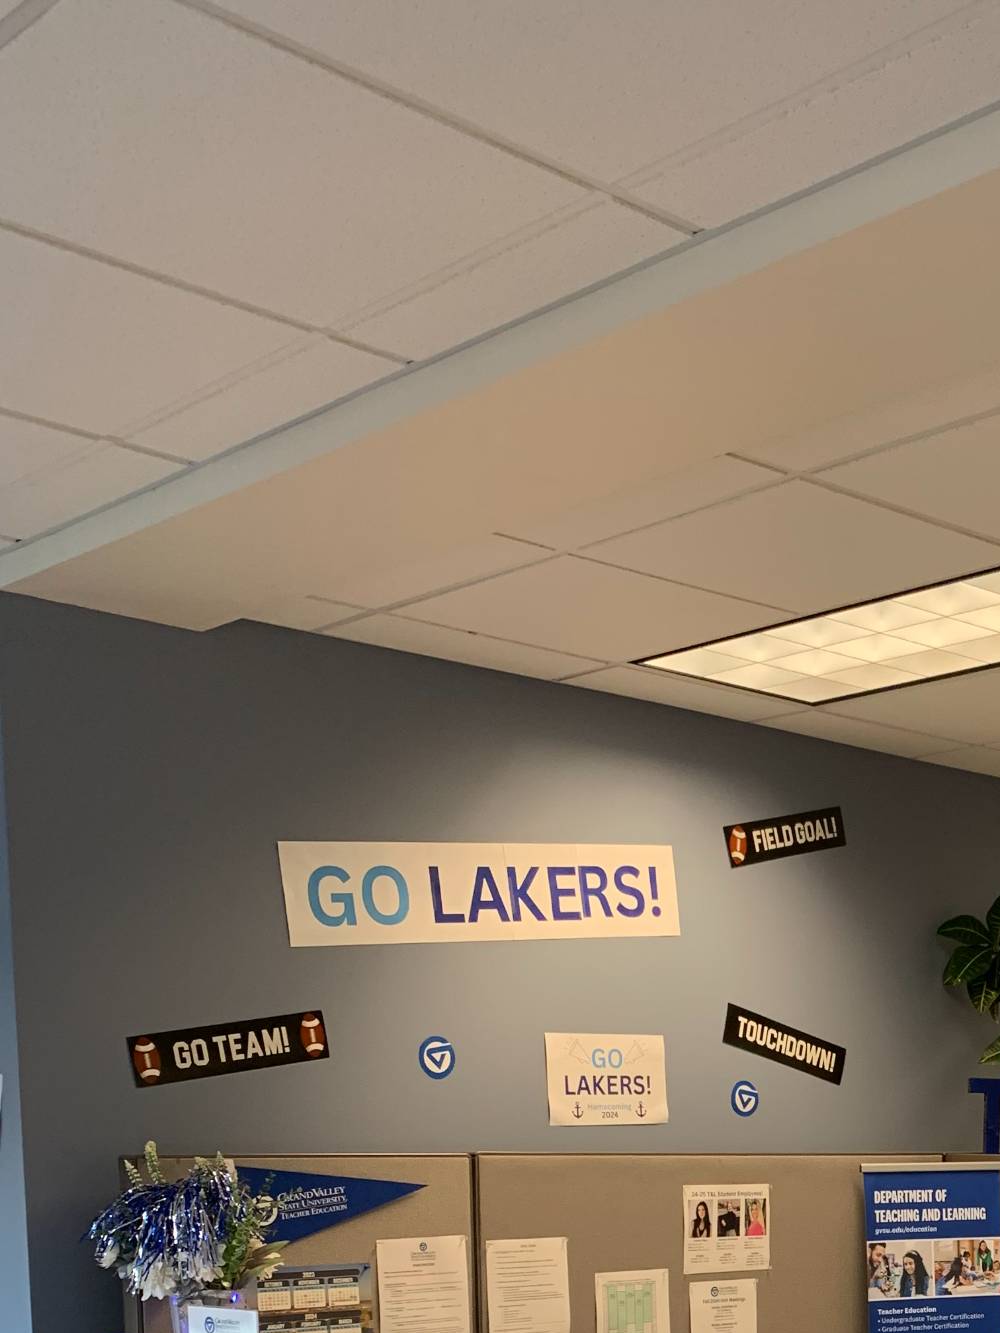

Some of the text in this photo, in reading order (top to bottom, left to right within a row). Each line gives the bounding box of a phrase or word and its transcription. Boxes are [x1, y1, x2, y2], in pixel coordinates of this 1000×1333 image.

[752, 816, 839, 855] FIELD GOAL!
[306, 865, 663, 928] GO LAKERS!
[172, 1026, 290, 1071] GO TEAM!
[736, 1017, 838, 1074] TOUCHDOWN!
[592, 1048, 624, 1069] GO
[564, 1075, 652, 1096] LAKERS!
[601, 1111, 619, 1119] 2024
[301, 1195, 348, 1208] UNIVERSITY
[873, 1189, 947, 1204] DEPARTMENT OF
[281, 1204, 348, 1220] TEACHER EDUCATION
[874, 1207, 987, 1223] TEACHING AND LEARNING
[875, 1226, 938, 1235] gvsu.edu/education
[904, 1306, 937, 1314] Education
[881, 1316, 926, 1324] Undergraduate
[934, 1322, 970, 1330] Certification
